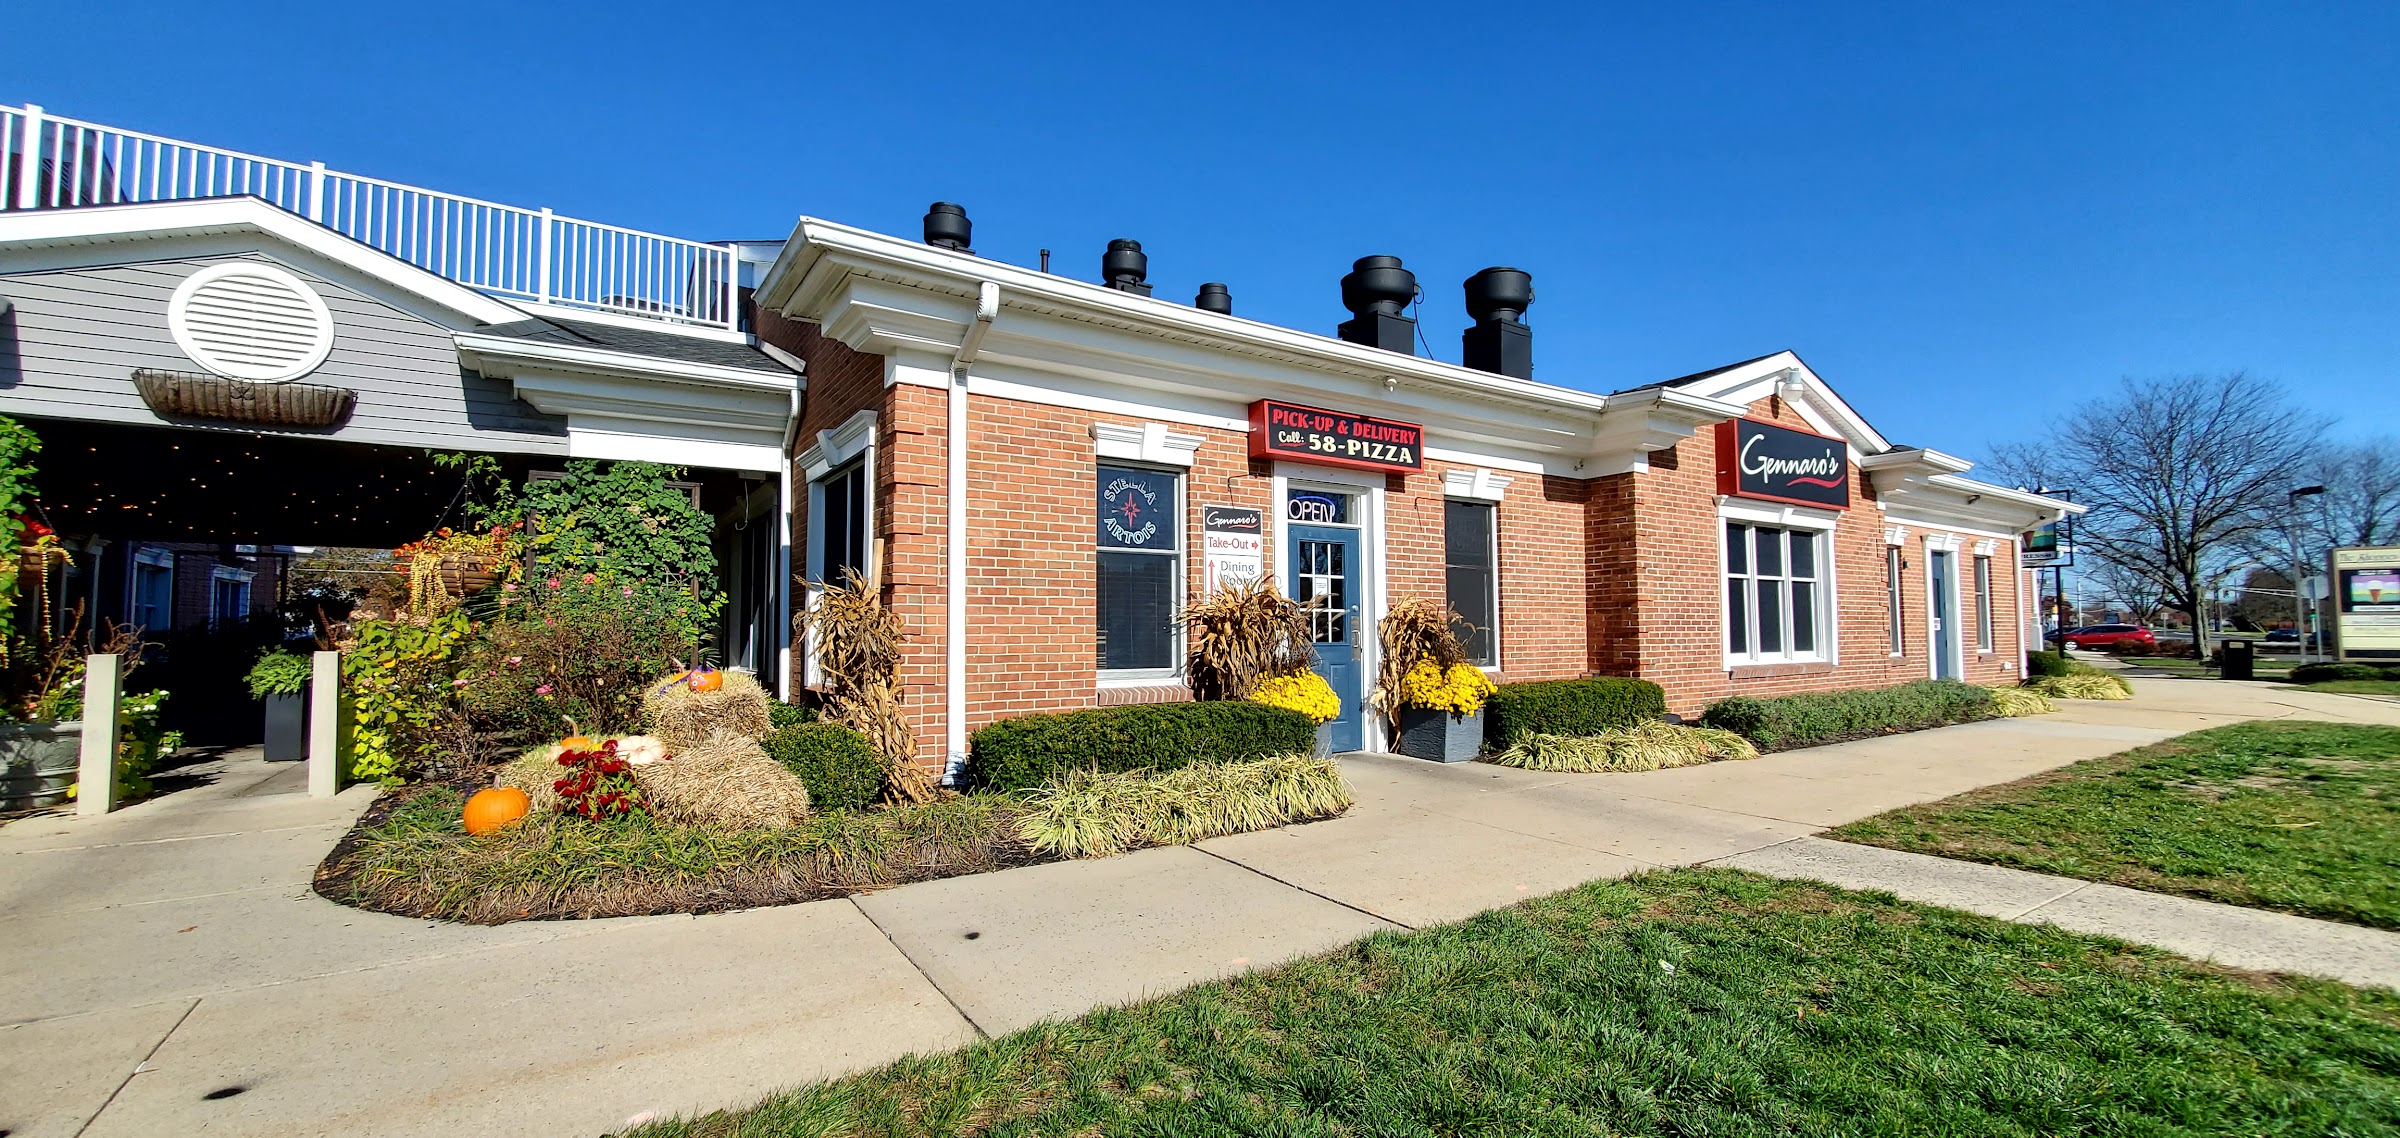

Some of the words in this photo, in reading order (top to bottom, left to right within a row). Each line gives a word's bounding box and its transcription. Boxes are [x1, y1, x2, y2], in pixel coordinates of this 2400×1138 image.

[1272, 408, 1334, 432] PICK-UP
[1337, 420, 1349, 435] &
[1353, 421, 1416, 445] DELIVERY
[1278, 430, 1305, 443] Call:
[1309, 433, 1414, 464] 58-PIZZA
[1740, 433, 1839, 484] Gennaro's
[1103, 476, 1156, 506] STELLA
[1206, 511, 1257, 527] Gennaro's
[1288, 499, 1333, 523] OPEN
[1103, 518, 1156, 545] ARTOIS
[1207, 536, 1249, 550] Take-Out
[1220, 560, 1255, 575] Dining
